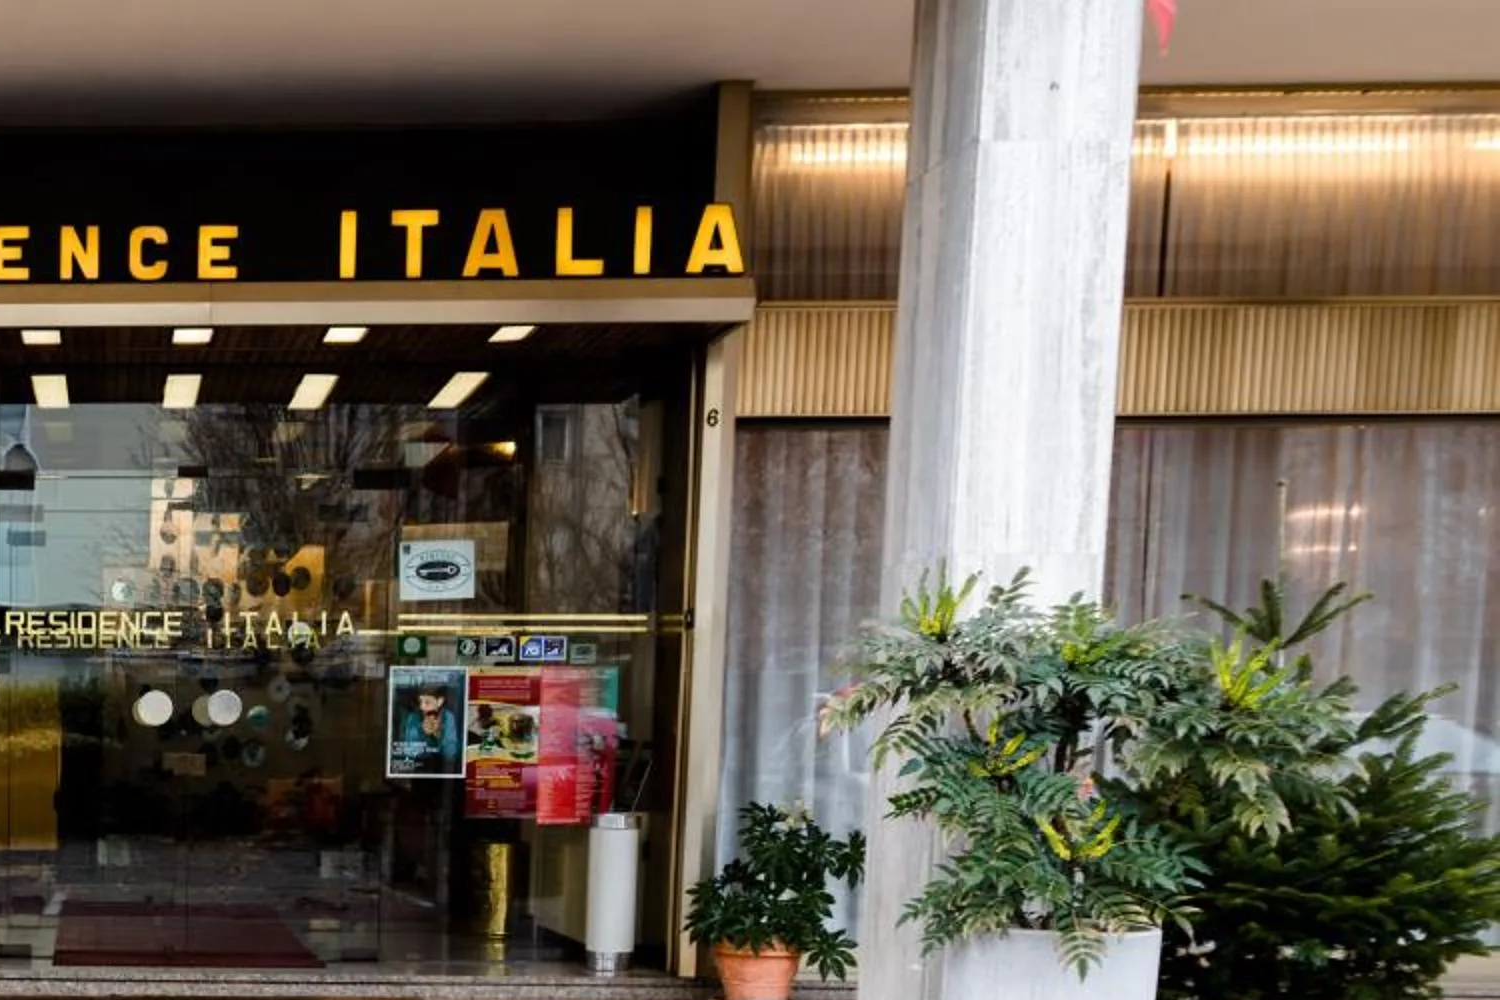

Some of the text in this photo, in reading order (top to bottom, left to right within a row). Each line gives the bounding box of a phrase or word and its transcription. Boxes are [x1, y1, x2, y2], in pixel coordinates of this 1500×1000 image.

[339, 203, 745, 279] ITALIA
[707, 408, 719, 427] 6
[4, 610, 356, 637] RESIDENCE ITALIA
